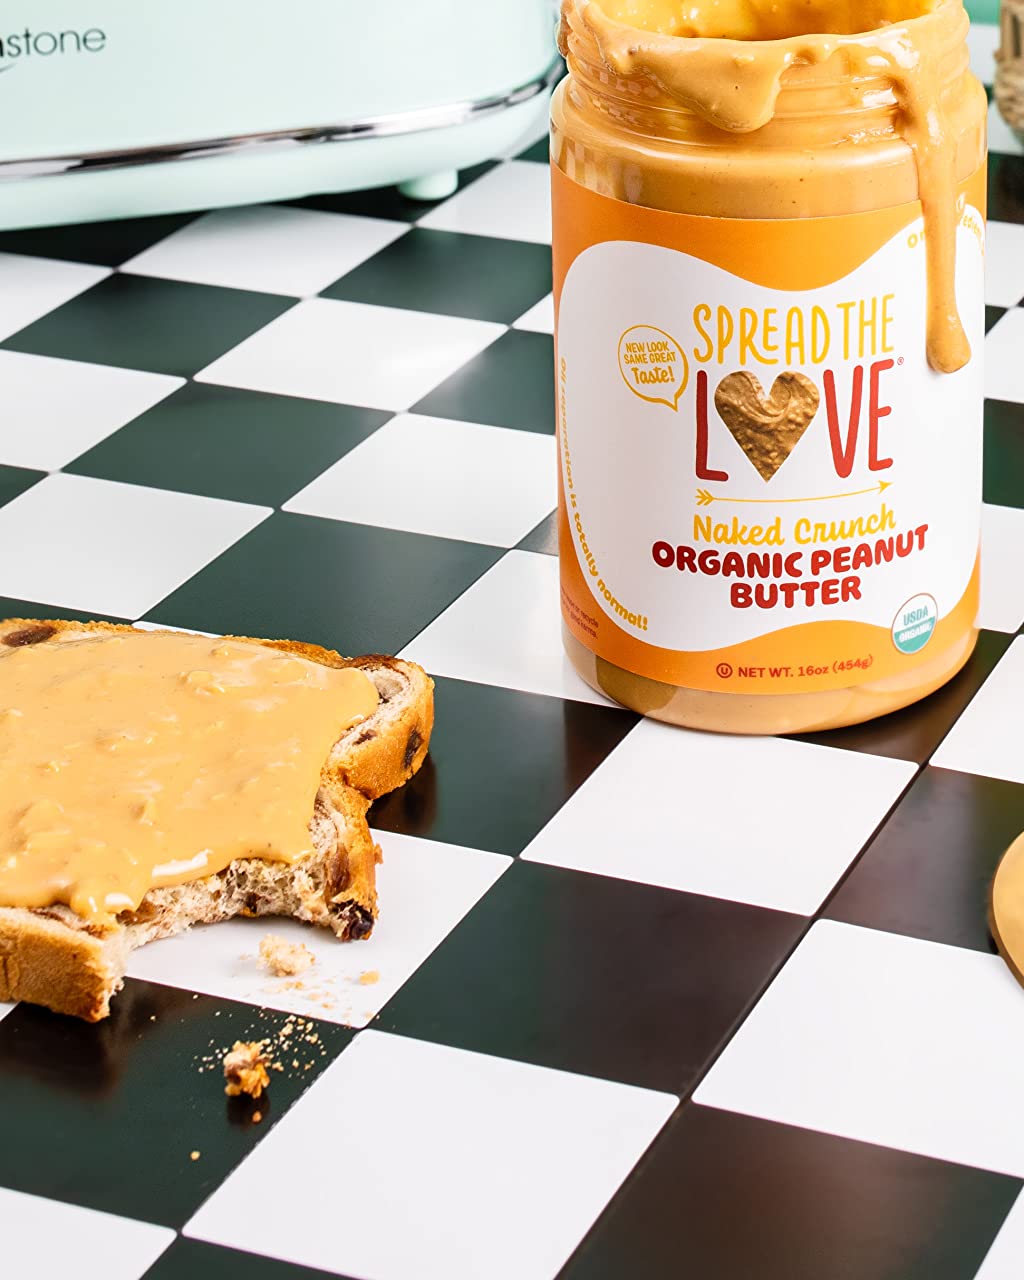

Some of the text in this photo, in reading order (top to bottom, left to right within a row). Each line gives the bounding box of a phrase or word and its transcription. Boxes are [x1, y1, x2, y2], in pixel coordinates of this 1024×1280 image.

[0, 27, 106, 58] stone
[693, 294, 895, 366] SPREAD THE
[623, 352, 676, 365] SAME GREAT
[625, 341, 669, 353] NEW LOOK
[631, 365, 675, 384] Taste!
[693, 503, 896, 546] Naked Crunch
[652, 524, 928, 578] ORGANIC PEANUT
[574, 512, 598, 577] totally
[597, 578, 648, 631] normal!
[730, 576, 862, 609] BUTTER
[903, 605, 928, 626] USDA
[898, 622, 932, 643] ORGANIC
[738, 667, 766, 678] NET
[769, 667, 794, 678] WT.
[798, 666, 830, 677] 16oz
[832, 654, 874, 674] (454g)
